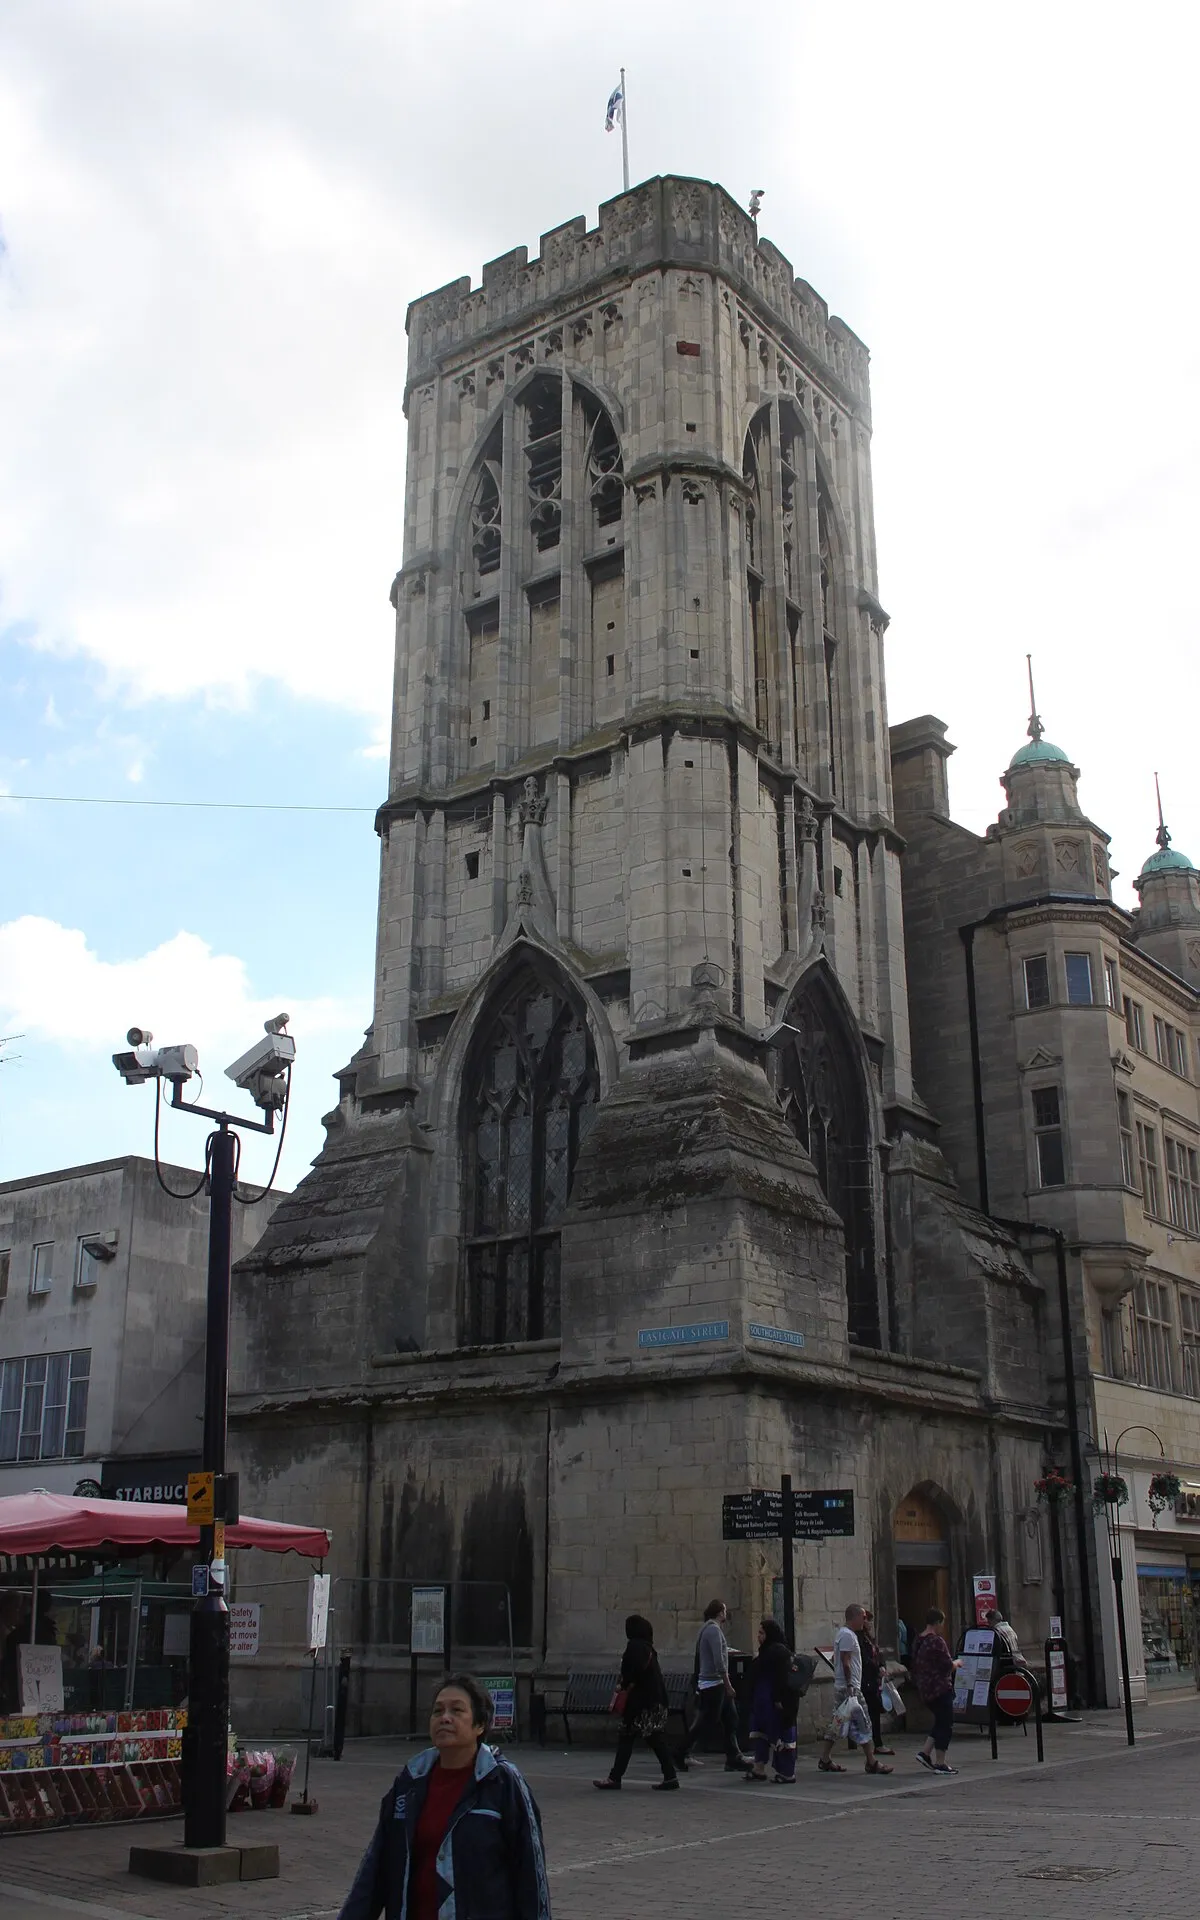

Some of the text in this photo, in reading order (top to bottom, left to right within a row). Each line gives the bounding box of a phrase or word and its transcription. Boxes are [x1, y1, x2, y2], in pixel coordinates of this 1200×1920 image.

[640, 1325, 724, 1343] EASTGATE STREET
[750, 1325, 802, 1344] SOUTHGATE STREET
[116, 1485, 188, 1501] STARBUC
[231, 1608, 253, 1618] Safety
[247, 1619, 257, 1628] do
[484, 1680, 510, 1688] SAFETY
